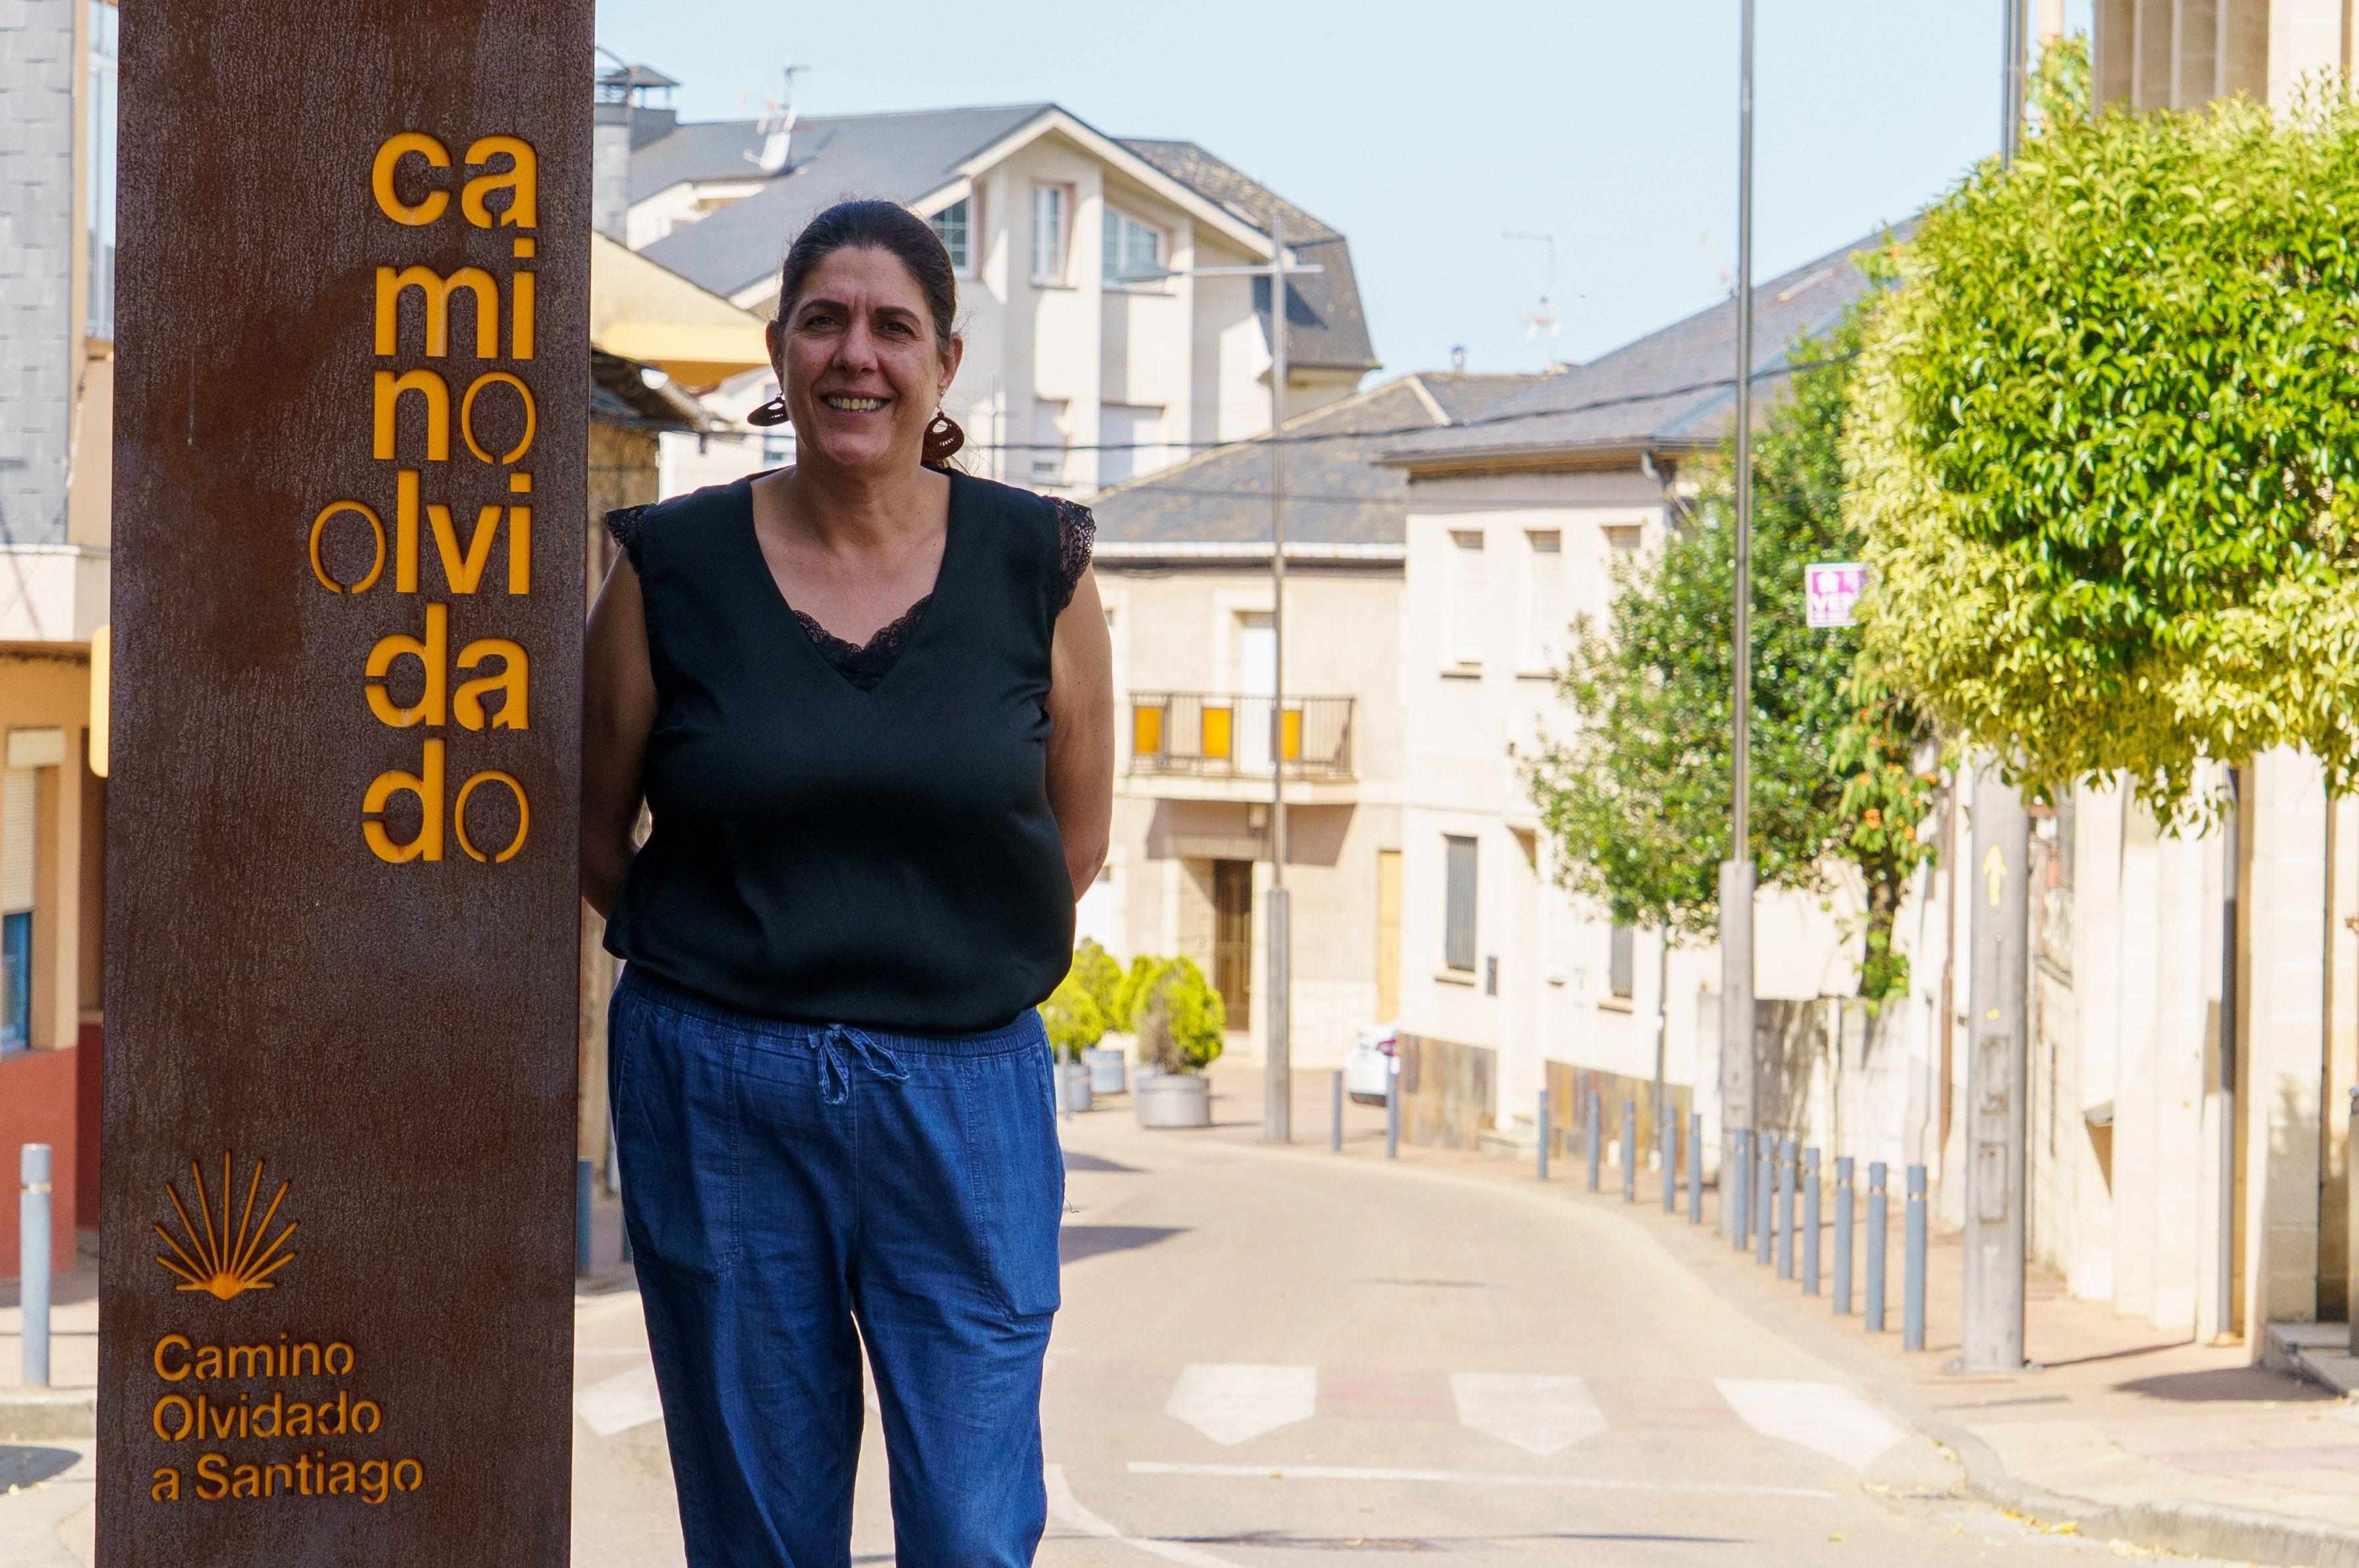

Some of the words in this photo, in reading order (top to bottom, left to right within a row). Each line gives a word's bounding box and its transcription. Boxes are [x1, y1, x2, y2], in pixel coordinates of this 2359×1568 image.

[372, 132, 538, 229] ca
[374, 237, 536, 360] mi
[373, 369, 537, 464] no
[308, 470, 532, 595] olvi
[364, 602, 529, 732] da
[362, 739, 530, 864] do
[154, 1332, 355, 1382] Camino
[152, 1390, 382, 1442] Olvidado
[151, 1468, 180, 1501] a
[196, 1452, 424, 1505] Santiago
